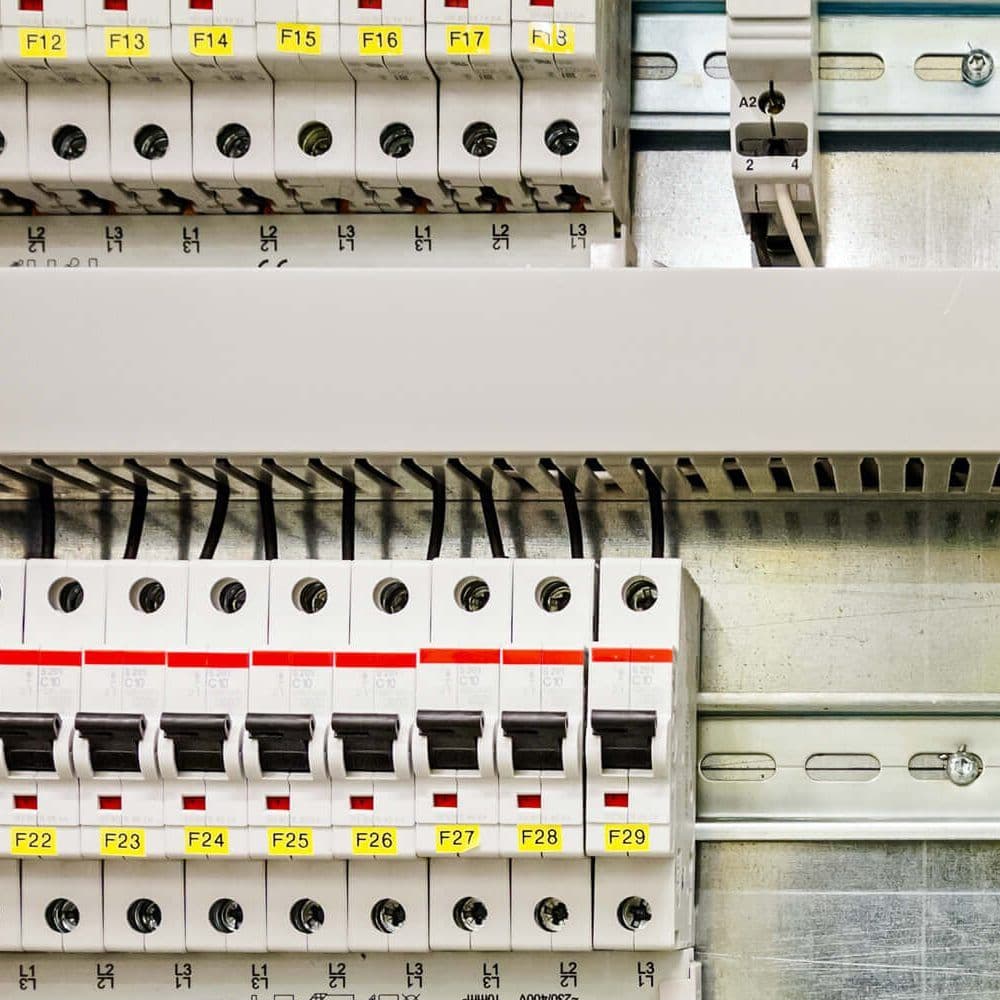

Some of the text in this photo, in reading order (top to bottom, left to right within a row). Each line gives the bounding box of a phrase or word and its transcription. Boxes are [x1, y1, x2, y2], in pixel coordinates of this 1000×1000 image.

[26, 34, 62, 51] F12
[109, 34, 145, 50] F13
[193, 33, 228, 48] F14
[280, 28, 317, 47] F15
[362, 32, 398, 48] F16
[449, 31, 484, 46] F17
[739, 97, 757, 108] A2
[746, 159, 798, 171] 2 4
[28, 227, 45, 239] L2
[105, 226, 124, 239] L3
[183, 226, 199, 239] L1
[260, 225, 278, 238] L2
[337, 225, 356, 238] L3
[415, 225, 430, 238] L1
[492, 224, 510, 236] L2
[570, 223, 587, 236] L3
[15, 832, 52, 848] F22
[105, 833, 141, 849] F23
[188, 831, 224, 847] F24
[272, 832, 309, 848] F25
[356, 832, 393, 848] F26
[439, 830, 475, 845] F27
[521, 829, 558, 845] F28
[609, 829, 646, 845] F29
[19, 965, 35, 977] L1
[97, 964, 114, 976] L2
[174, 963, 192, 976] L3
[252, 964, 267, 976] L1
[329, 963, 346, 975] L2
[406, 963, 423, 975] L3
[483, 963, 499, 975] L1
[560, 962, 577, 974] L2
[637, 961, 655, 974] L3
